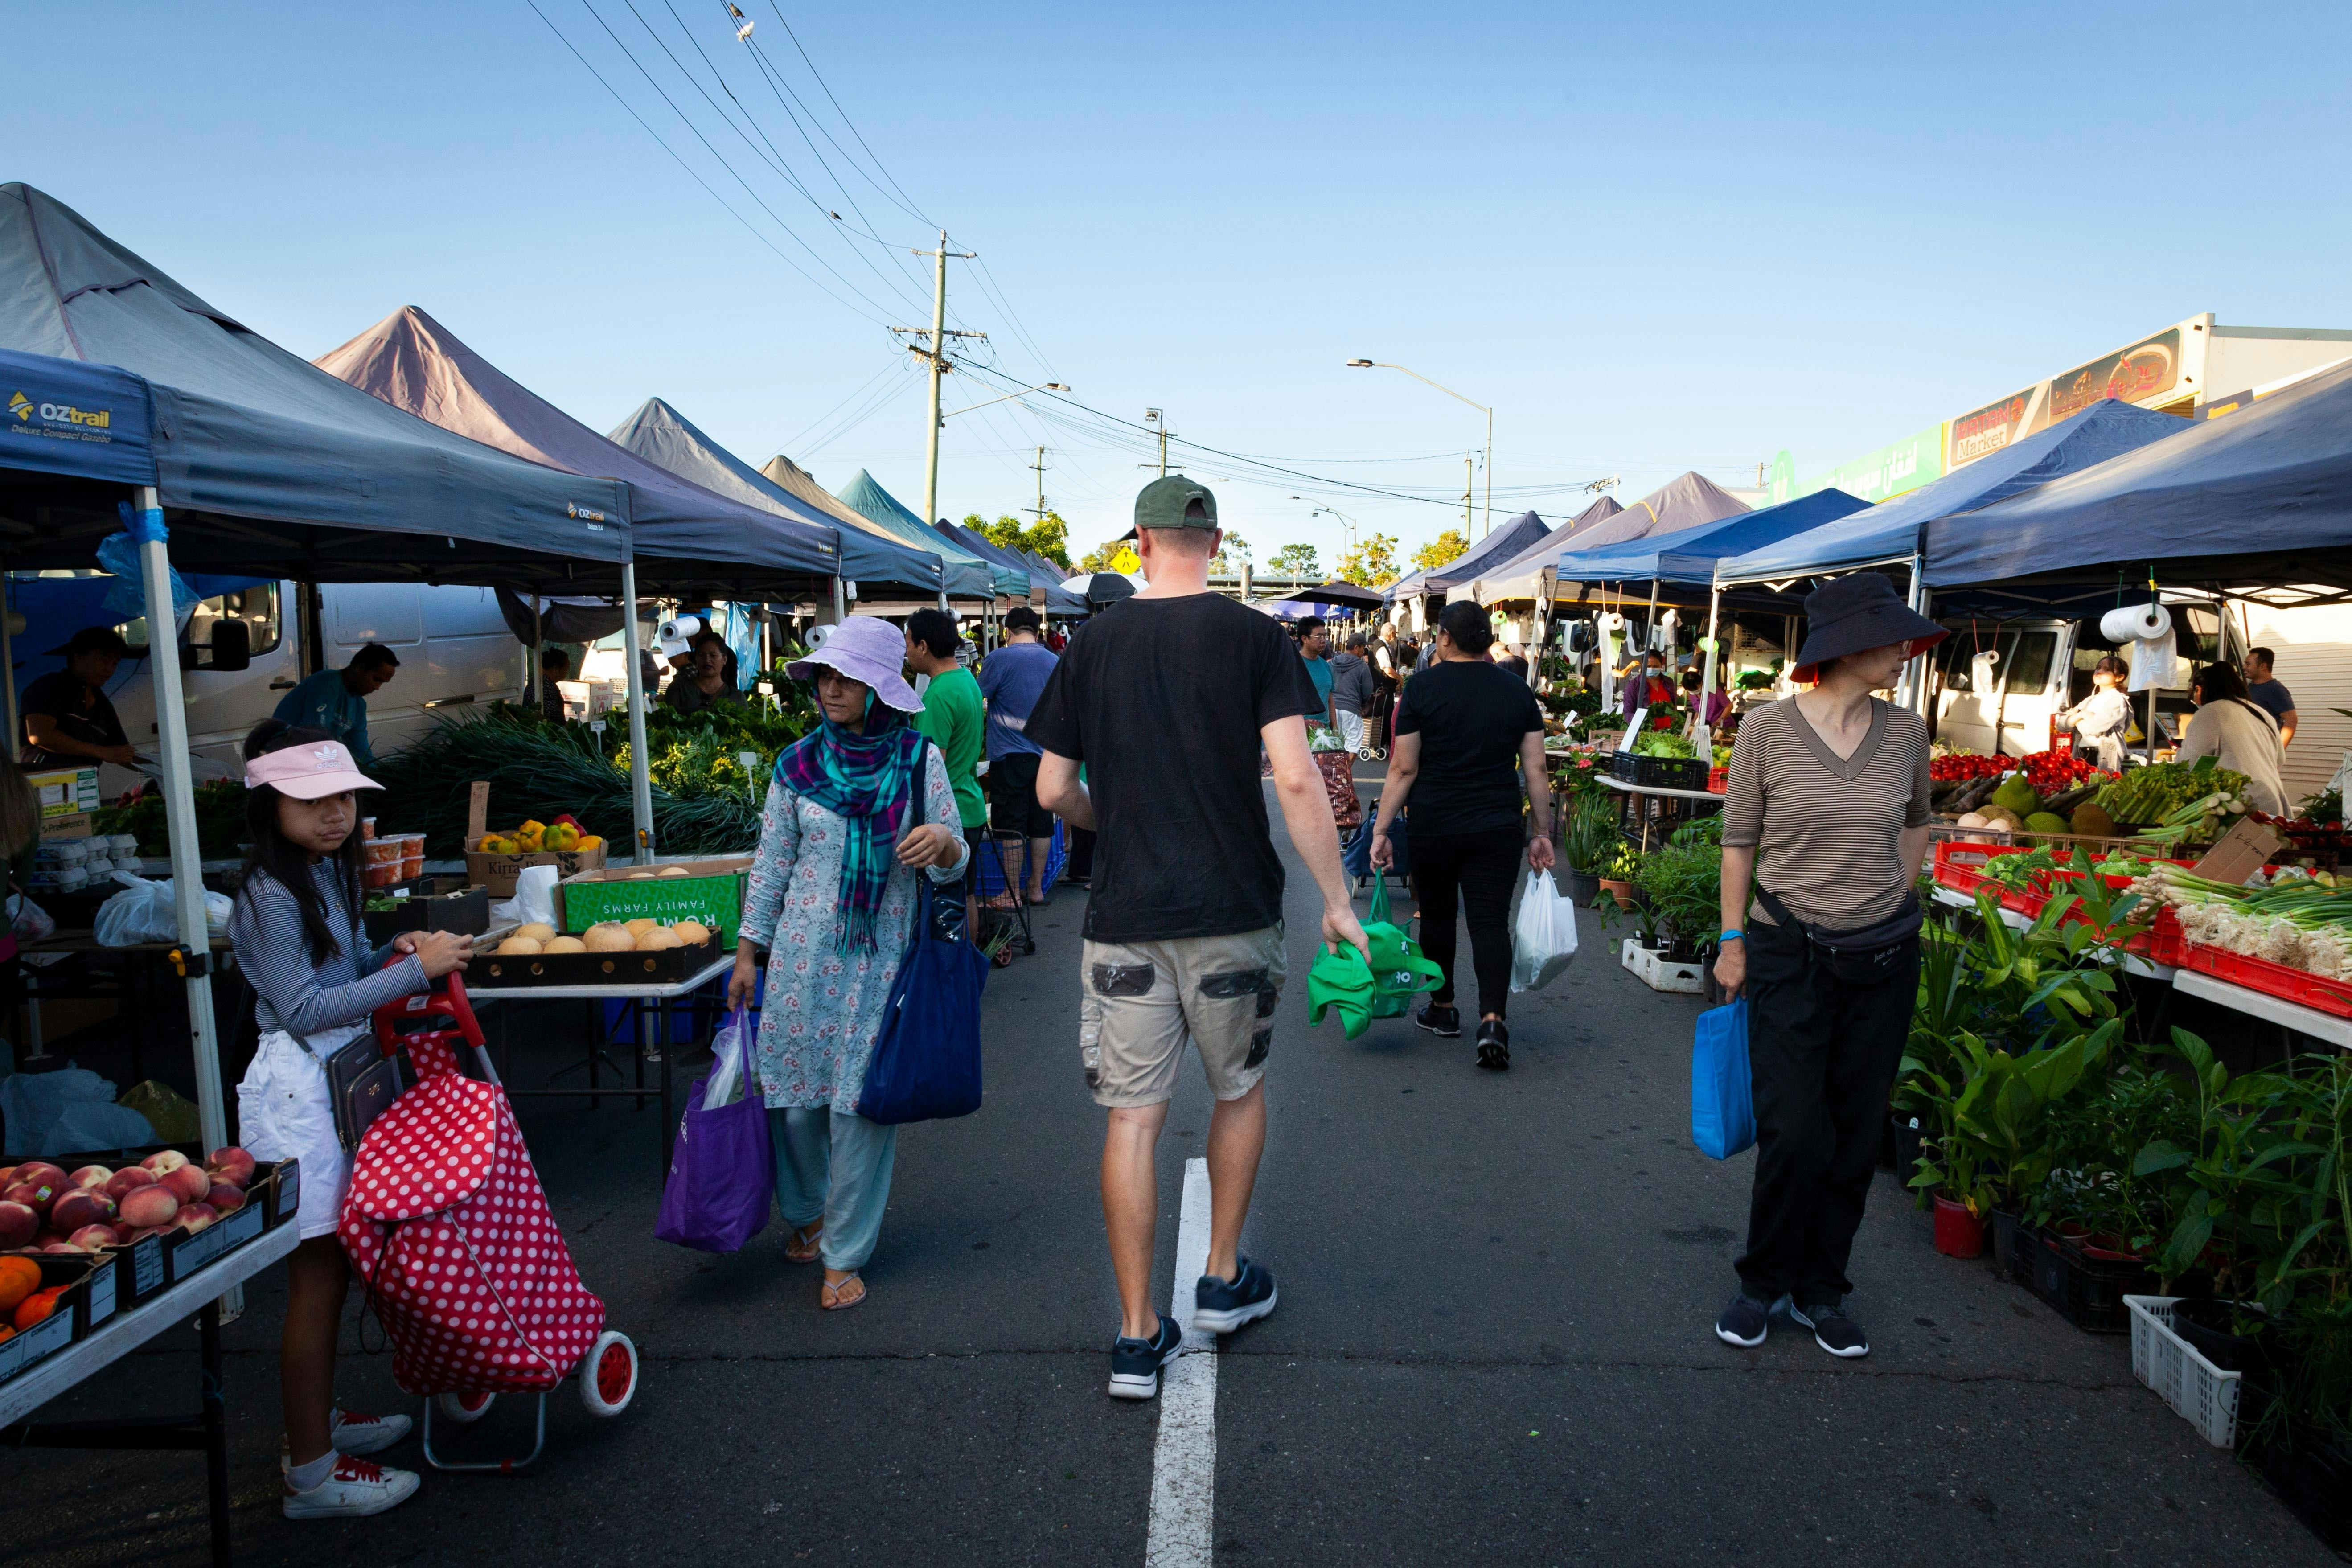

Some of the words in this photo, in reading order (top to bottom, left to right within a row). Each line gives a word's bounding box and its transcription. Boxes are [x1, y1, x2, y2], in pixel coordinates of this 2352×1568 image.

[40, 402, 110, 428] OZtrail
[1956, 402, 2010, 440] WATAN
[12, 424, 41, 435] Deluxe
[43, 428, 80, 440] Compact
[81, 433, 111, 443] Gazebo
[1959, 430, 2004, 458] Market
[488, 862, 520, 874] Kirra
[603, 903, 648, 914] FARMS
[656, 900, 705, 912] FAMILY
[1874, 951, 1886, 963] Just
[229, 1207, 251, 1223] CONSIGNED
[31, 1315, 61, 1337] CONSIGNED
[62, 1311, 68, 1319] TO
